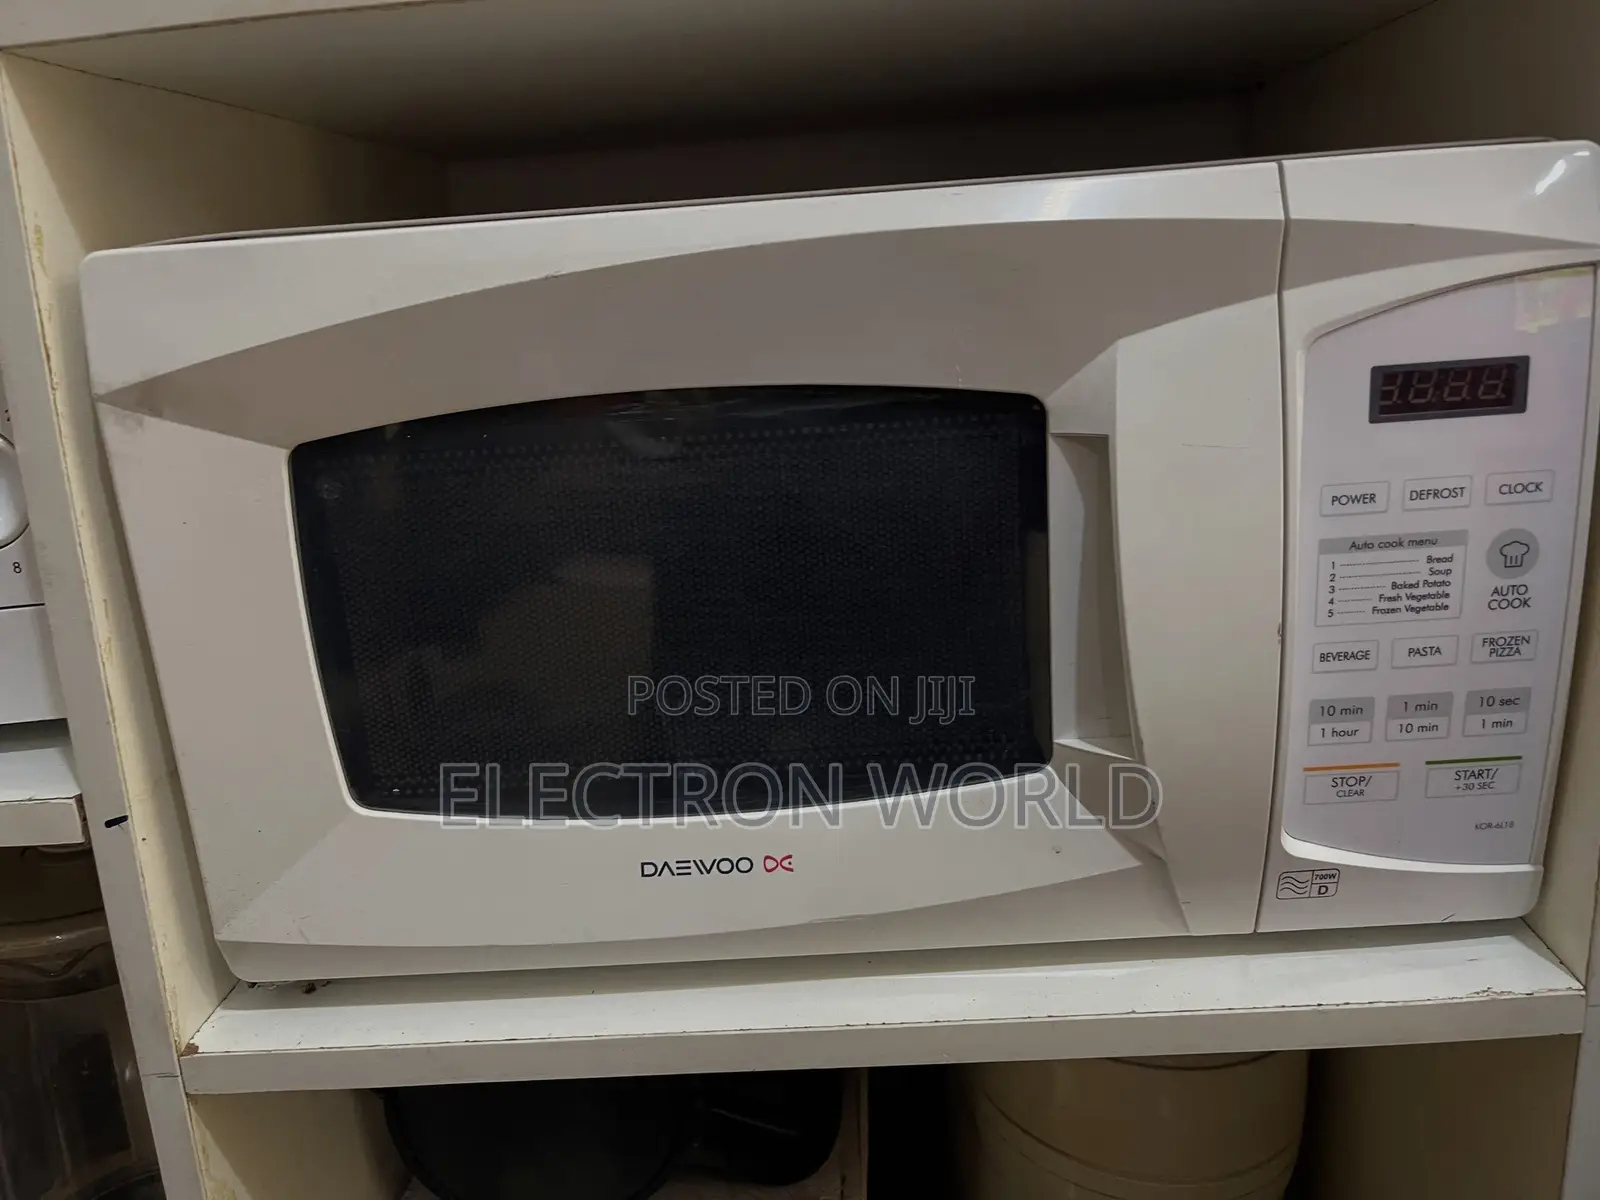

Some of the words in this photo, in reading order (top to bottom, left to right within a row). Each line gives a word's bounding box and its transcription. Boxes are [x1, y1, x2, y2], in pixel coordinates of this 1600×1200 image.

[1409, 486, 1466, 501] DEFROST
[1498, 481, 1544, 496] CLOCK
[1331, 493, 1377, 507] POWER
[1349, 540, 1375, 551] Auto
[1378, 537, 1405, 549] cook
[1407, 537, 1439, 547] menu
[13, 561, 22, 574] 8
[1331, 561, 1336, 570] 1
[1426, 554, 1454, 564] Bread
[1329, 573, 1336, 582] 2
[1428, 567, 1453, 578] Soup
[1328, 585, 1335, 594] 3
[1391, 581, 1420, 590] Baked
[1422, 578, 1452, 588] Potato
[1491, 584, 1529, 597] AUTO
[1327, 597, 1335, 606] 4
[1378, 593, 1403, 603] Fresh
[1405, 590, 1451, 603] Vegetable
[1487, 597, 1532, 611] COOK
[1327, 609, 1334, 618] 5
[1371, 605, 1402, 615] Frozen
[1404, 602, 1450, 615] Vegetable
[1482, 635, 1531, 648] FROZEN
[1319, 650, 1371, 663] BEVERAGE
[1407, 645, 1442, 657] PASTA
[1489, 647, 1522, 658] PIZZA
[1403, 701, 1409, 713] 1
[1414, 699, 1439, 712] min
[1479, 696, 1496, 708] 10
[1498, 696, 1521, 707] sec
[1319, 705, 1336, 717] 10
[1339, 704, 1364, 716] min
[1399, 723, 1414, 734] 10
[1417, 721, 1439, 733] min
[1481, 718, 1486, 730] 1
[1491, 717, 1513, 729] min
[1320, 727, 1326, 738] 1
[1331, 726, 1359, 738] hour
[1454, 767, 1499, 781] START/
[1331, 775, 1373, 789] STOP/
[1455, 783, 1474, 792] +30
[1477, 781, 1496, 790] SEC
[1336, 789, 1365, 798] CLEAR
[641, 856, 754, 878] DAEWOO
[1314, 872, 1338, 881] 700W
[1317, 885, 1329, 896] D
